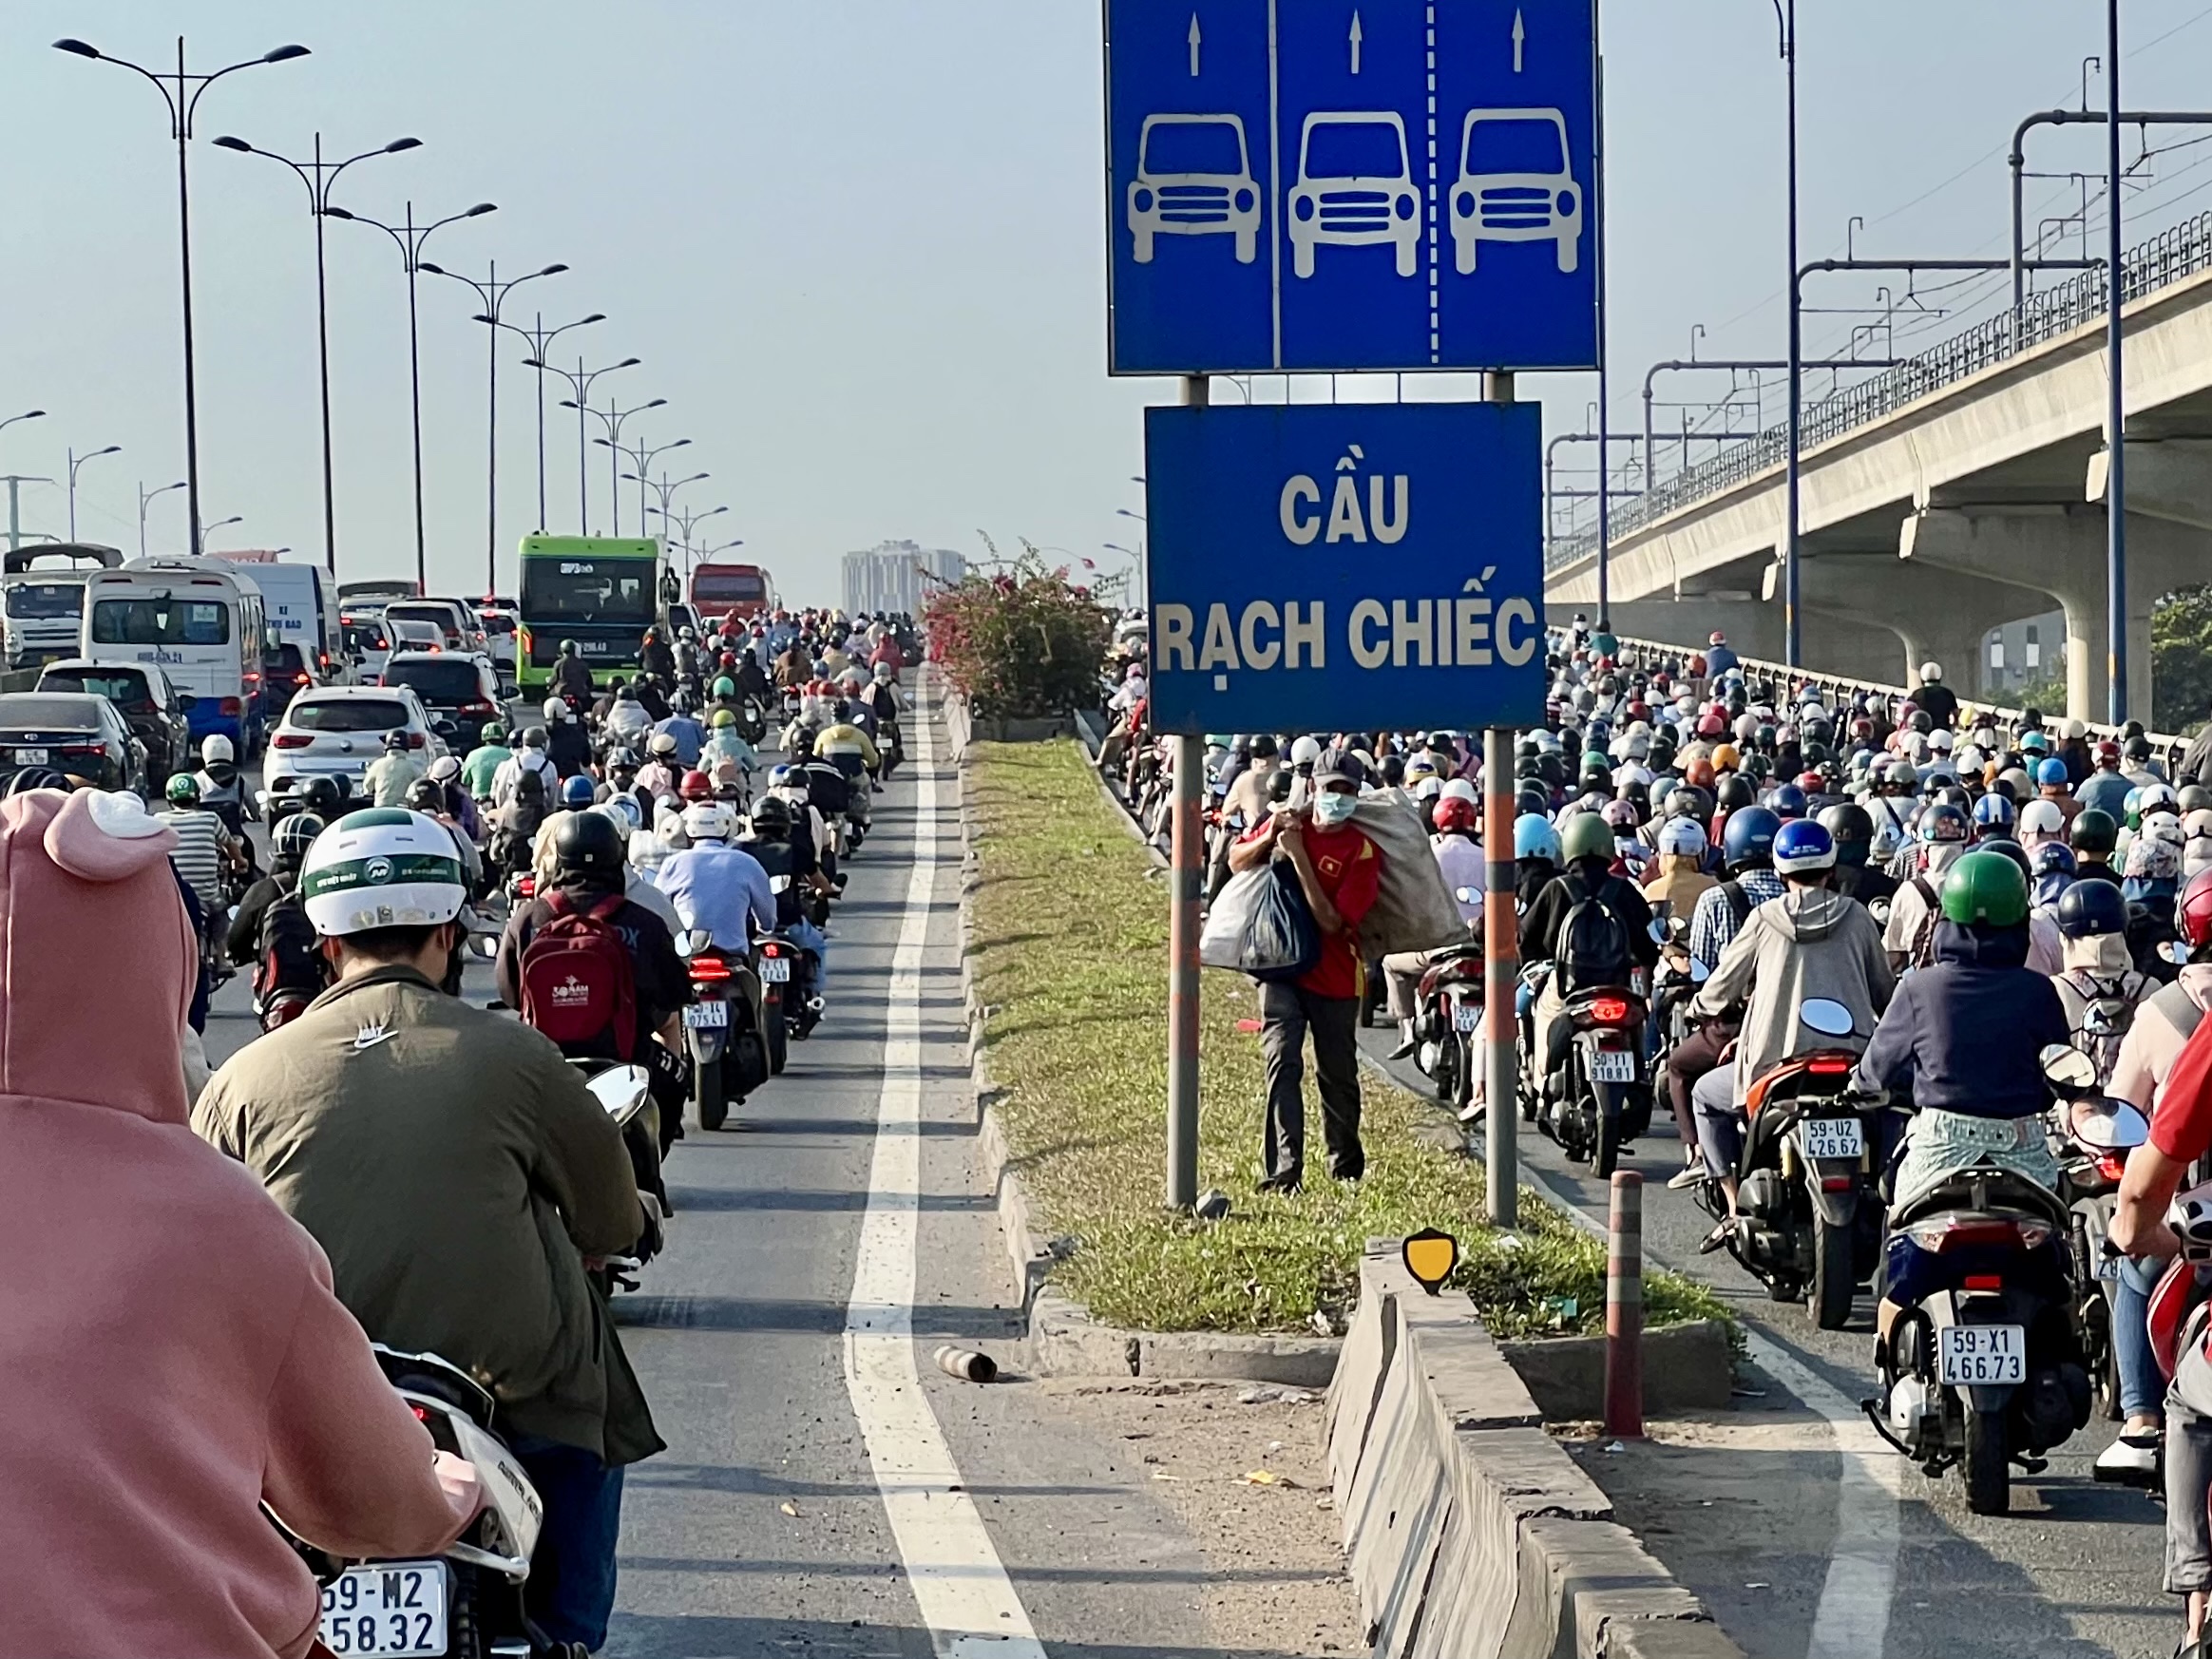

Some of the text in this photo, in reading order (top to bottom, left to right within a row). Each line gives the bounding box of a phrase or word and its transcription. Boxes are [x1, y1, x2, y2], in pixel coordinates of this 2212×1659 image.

[1279, 444, 1409, 545] CẦU
[1154, 565, 1536, 692] RẠCH CHIẾC
[1809, 1120, 1854, 1137] 59-U2
[1808, 1138, 1859, 1156] 426.62
[1953, 1330, 2010, 1354] 59-X1
[1947, 1355, 2021, 1381] 466.73
